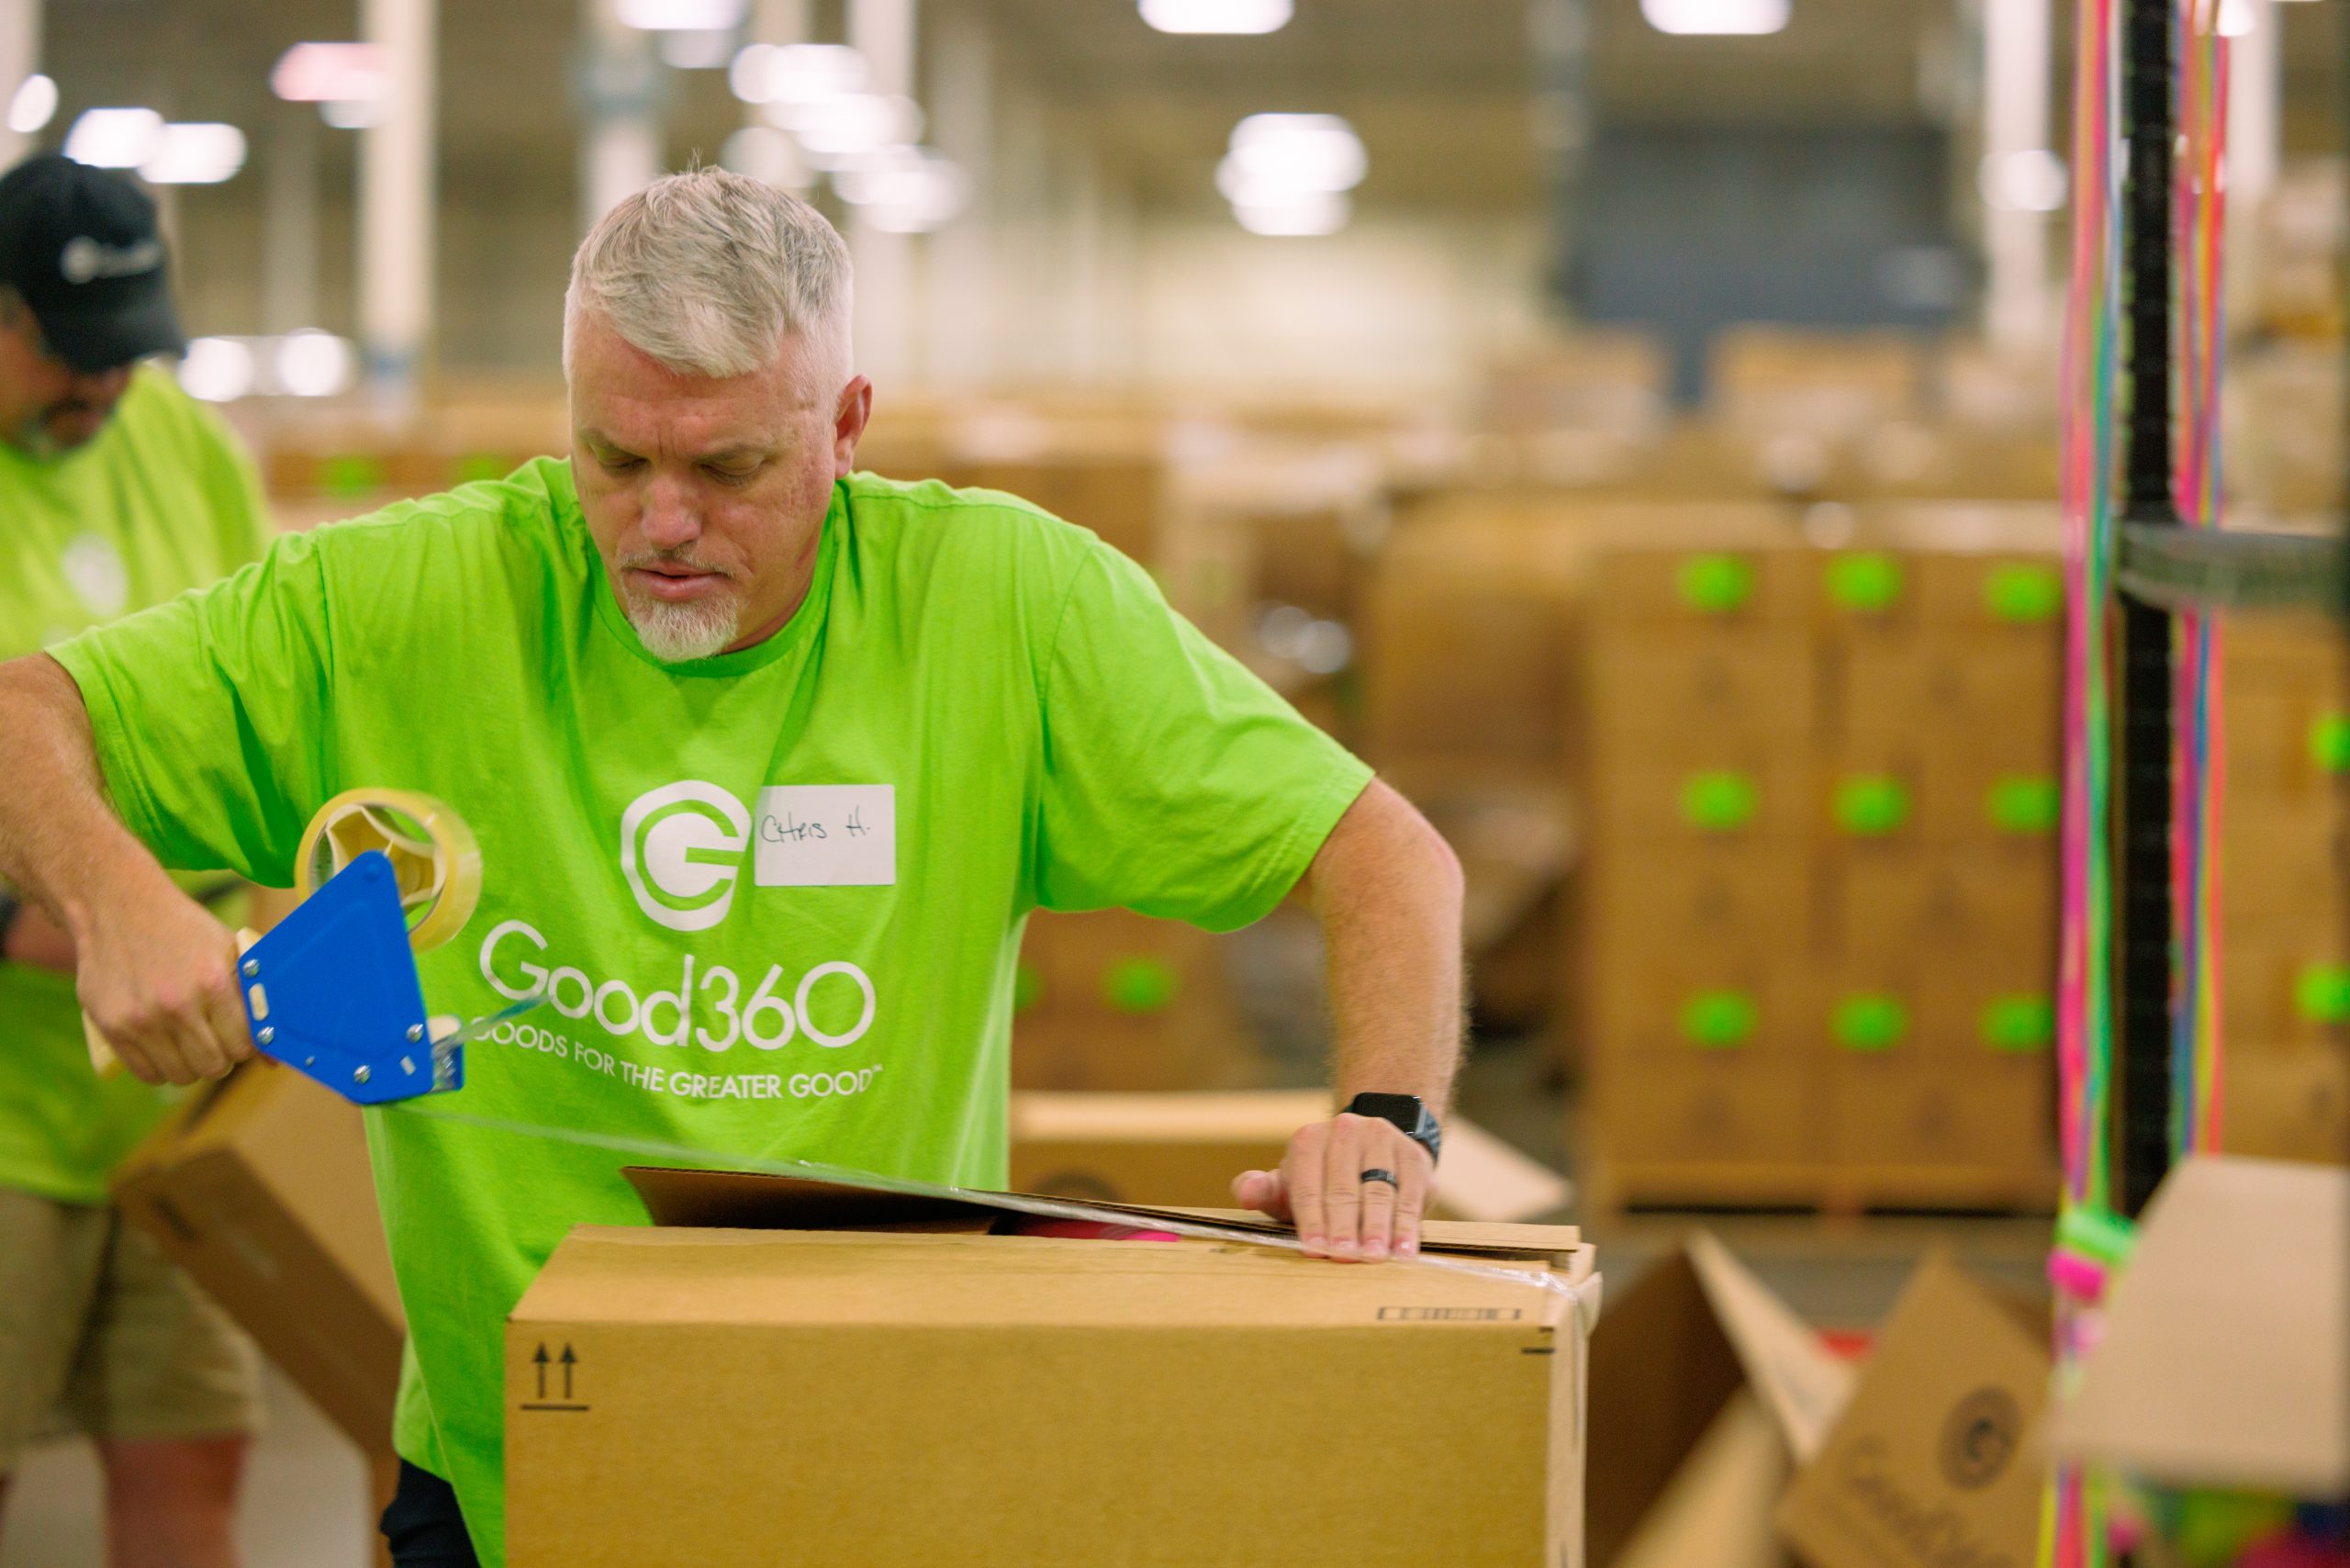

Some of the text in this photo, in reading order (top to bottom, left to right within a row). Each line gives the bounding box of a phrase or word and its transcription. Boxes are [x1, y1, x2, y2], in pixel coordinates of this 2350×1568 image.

[479, 920, 876, 1053] Good360
[575, 1041, 616, 1077] FOR
[620, 1059, 666, 1093] THE
[668, 1071, 782, 1099] GREATER
